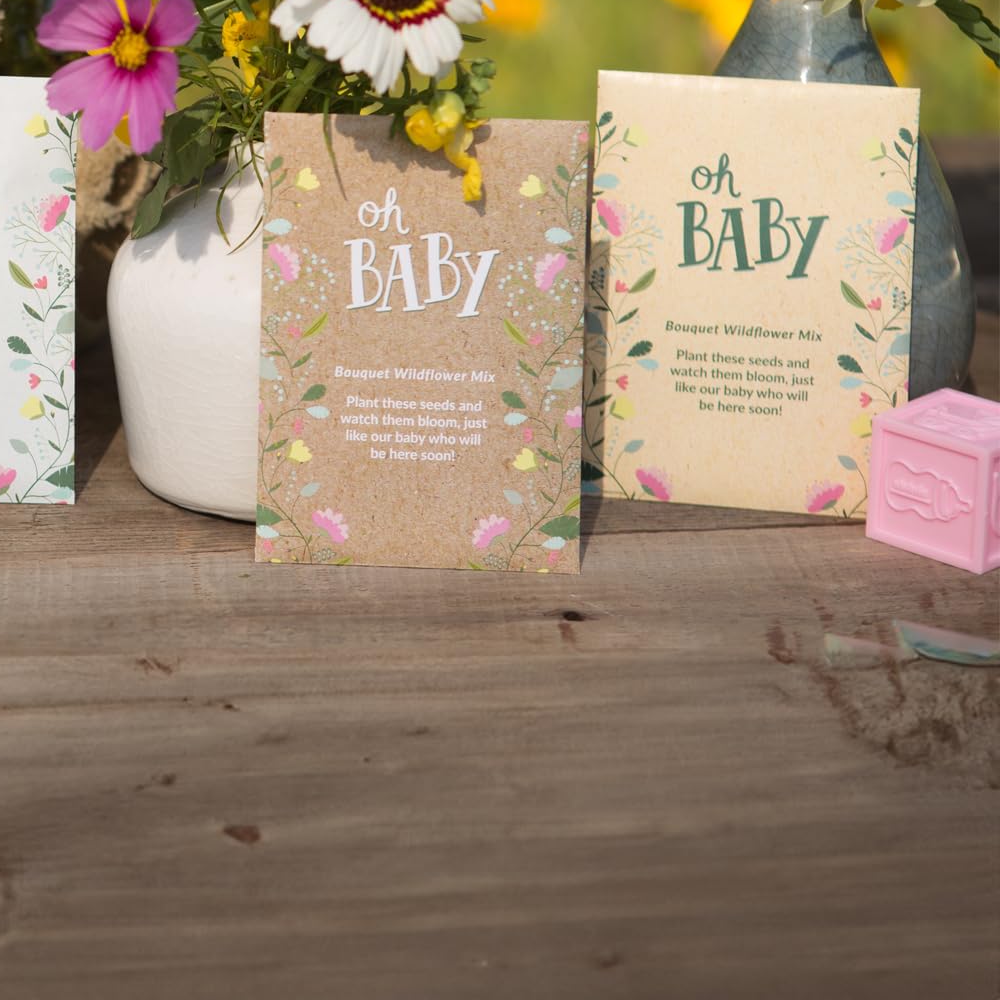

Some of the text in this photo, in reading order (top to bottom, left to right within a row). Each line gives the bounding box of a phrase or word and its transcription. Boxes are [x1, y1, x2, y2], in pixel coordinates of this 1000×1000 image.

[692, 153, 741, 198] oh
[358, 187, 410, 234] oh
[676, 198, 829, 279] BABY
[344, 232, 500, 318] BABY
[666, 321, 822, 341] Bouquet Wildflower Mix
[676, 349, 810, 368] Plant these seeds and
[335, 366, 495, 382] Bouquet Wildflower Mix
[670, 367, 814, 386] watch them bloom, just
[676, 382, 808, 401] like our baby who will
[347, 396, 482, 412] Plant these seeds and
[699, 400, 782, 415] be here soon!
[340, 414, 487, 430] watch them bloom, just
[346, 430, 481, 445] like our baby who will
[371, 448, 456, 461] be here soon!
